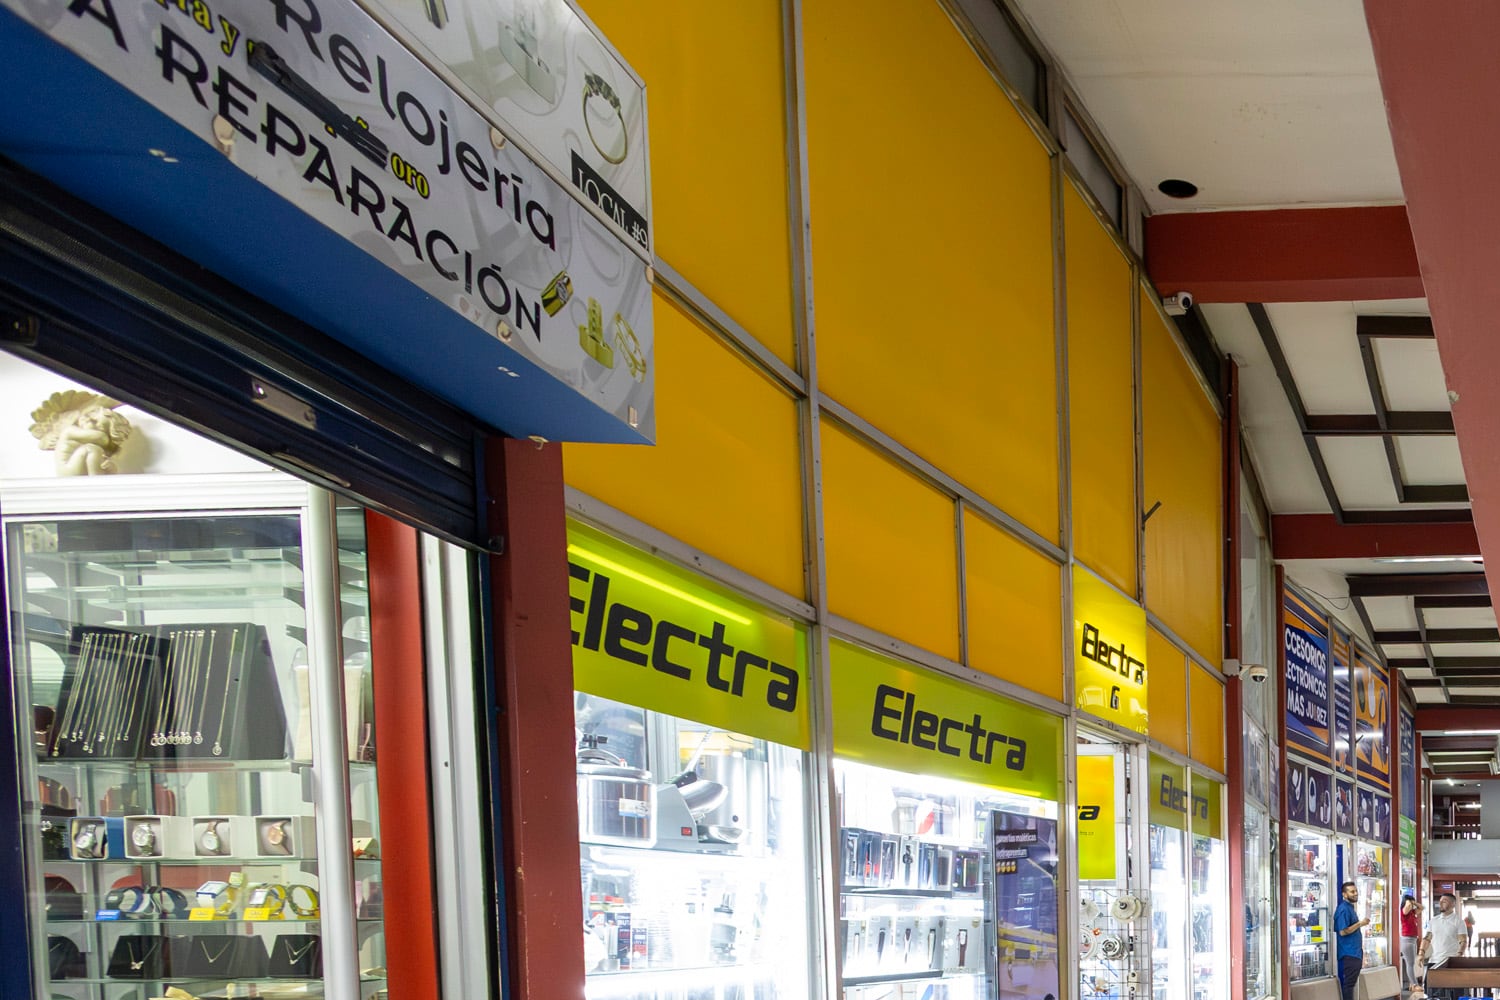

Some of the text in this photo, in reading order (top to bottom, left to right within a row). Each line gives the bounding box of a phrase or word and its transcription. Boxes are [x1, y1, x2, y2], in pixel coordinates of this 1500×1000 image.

[155, 23, 541, 343] REPARACIÓN
[390, 152, 431, 199] oro
[1081, 622, 1145, 685] Electra
[871, 683, 1027, 772] Electra
[1287, 686, 1305, 717] MÁS
